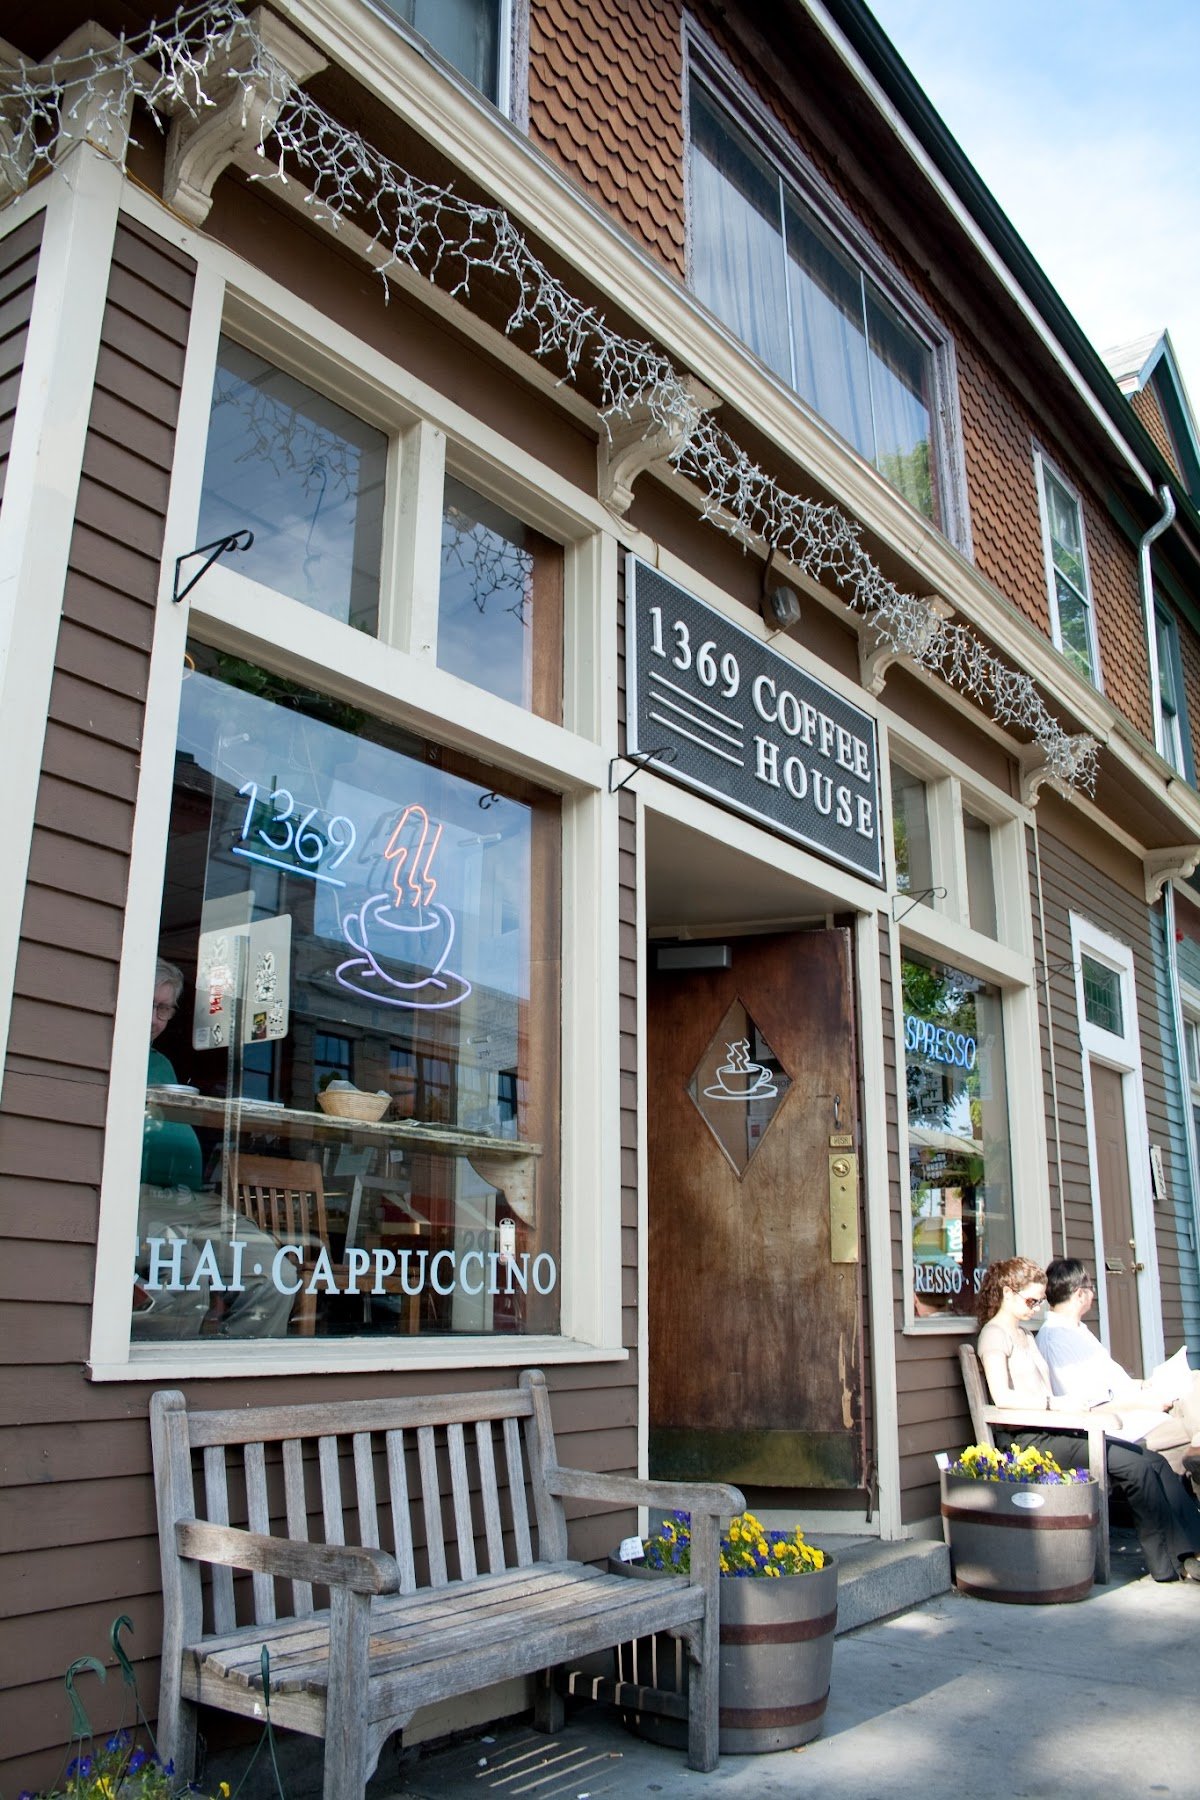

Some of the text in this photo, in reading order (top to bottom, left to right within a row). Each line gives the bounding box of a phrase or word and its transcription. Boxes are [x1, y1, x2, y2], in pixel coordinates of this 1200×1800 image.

[650, 607, 871, 783] 1369 COFFEE
[237, 782, 357, 870] 1369
[753, 736, 874, 839] HOUSE
[904, 1015, 976, 1070] SPRESSO
[133, 1236, 557, 1296] HAI CAPPUCCINO
